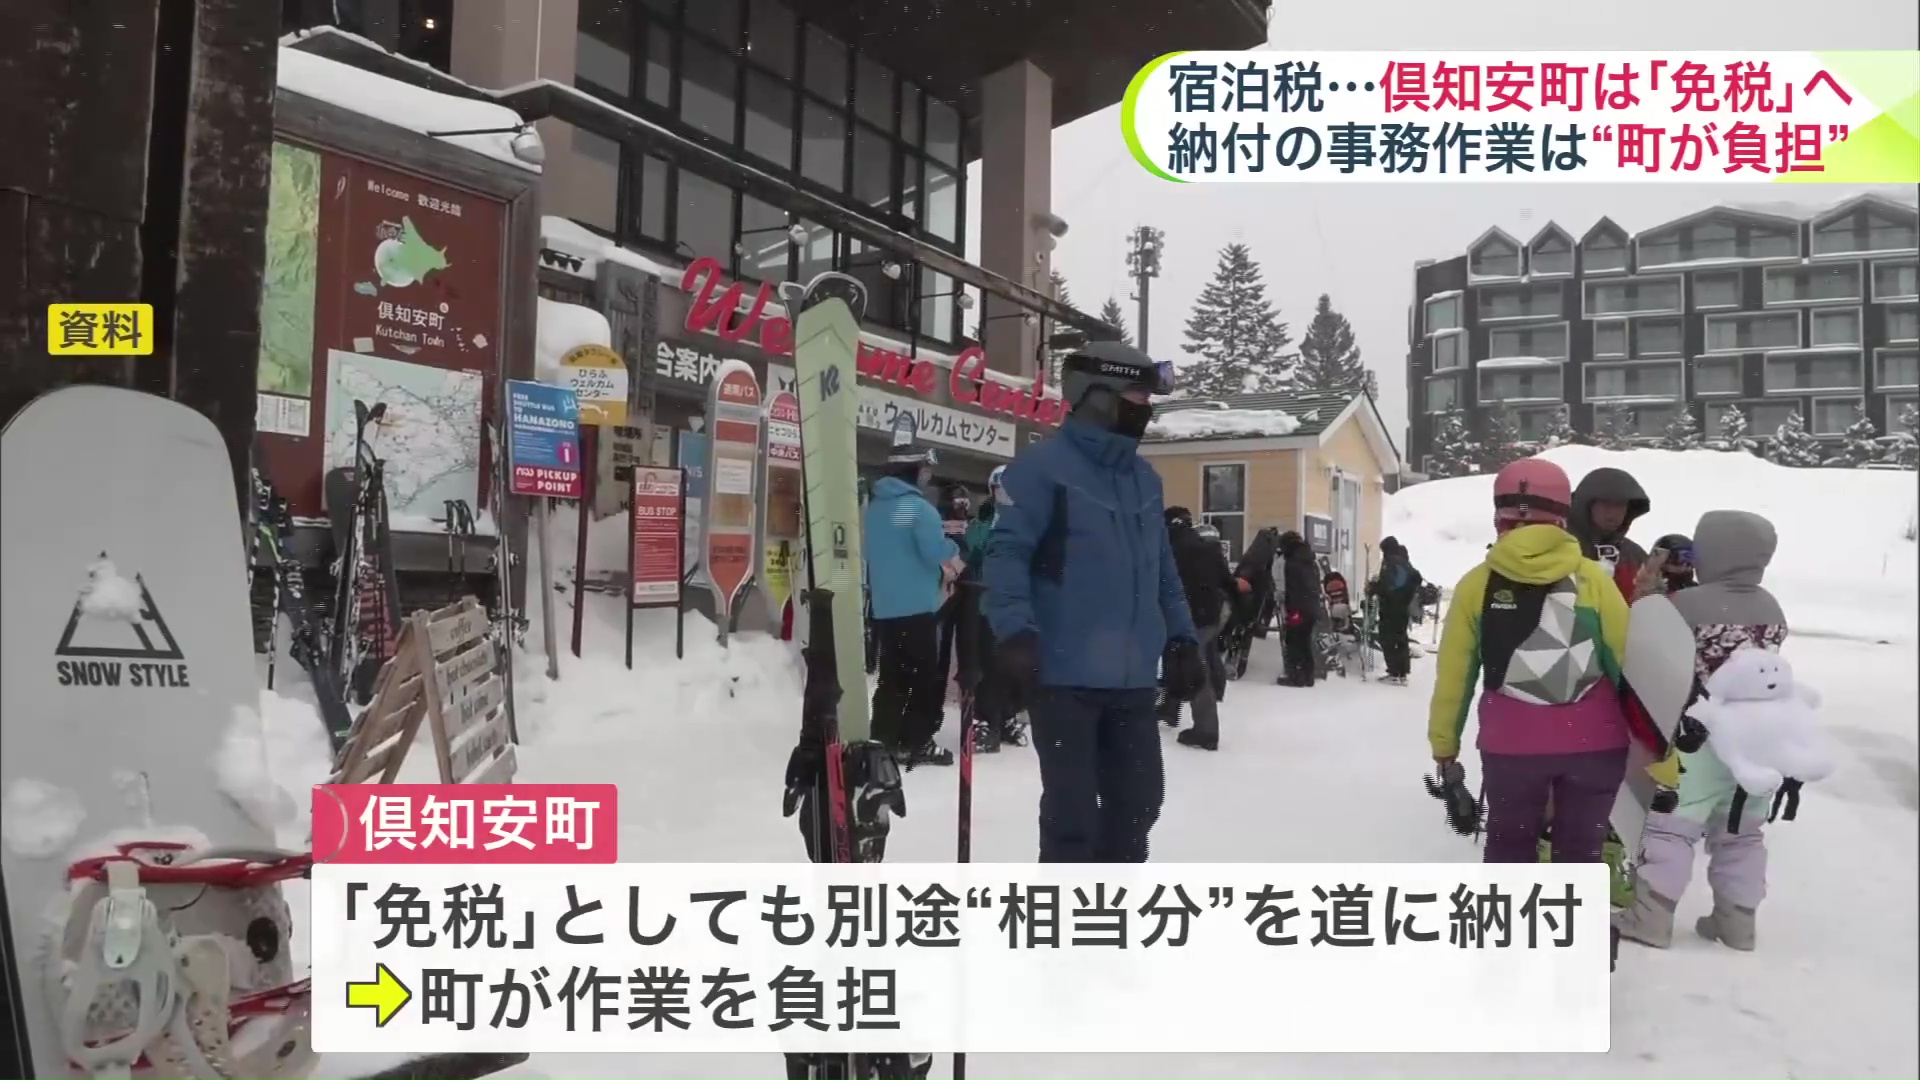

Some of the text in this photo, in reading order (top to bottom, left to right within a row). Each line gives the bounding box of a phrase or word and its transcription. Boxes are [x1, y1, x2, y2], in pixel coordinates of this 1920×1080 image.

[375, 324, 446, 348] Kutchan Town
[819, 364, 840, 402] K2
[949, 346, 1071, 426] Center
[514, 413, 575, 430] HANAZONO
[884, 401, 1010, 446] ウルカムセンター
[536, 468, 578, 481] PICKUP
[537, 480, 572, 493] POINT
[637, 505, 656, 516] BUS
[655, 506, 678, 517] STOP
[56, 661, 191, 688] SNOW STYLE
